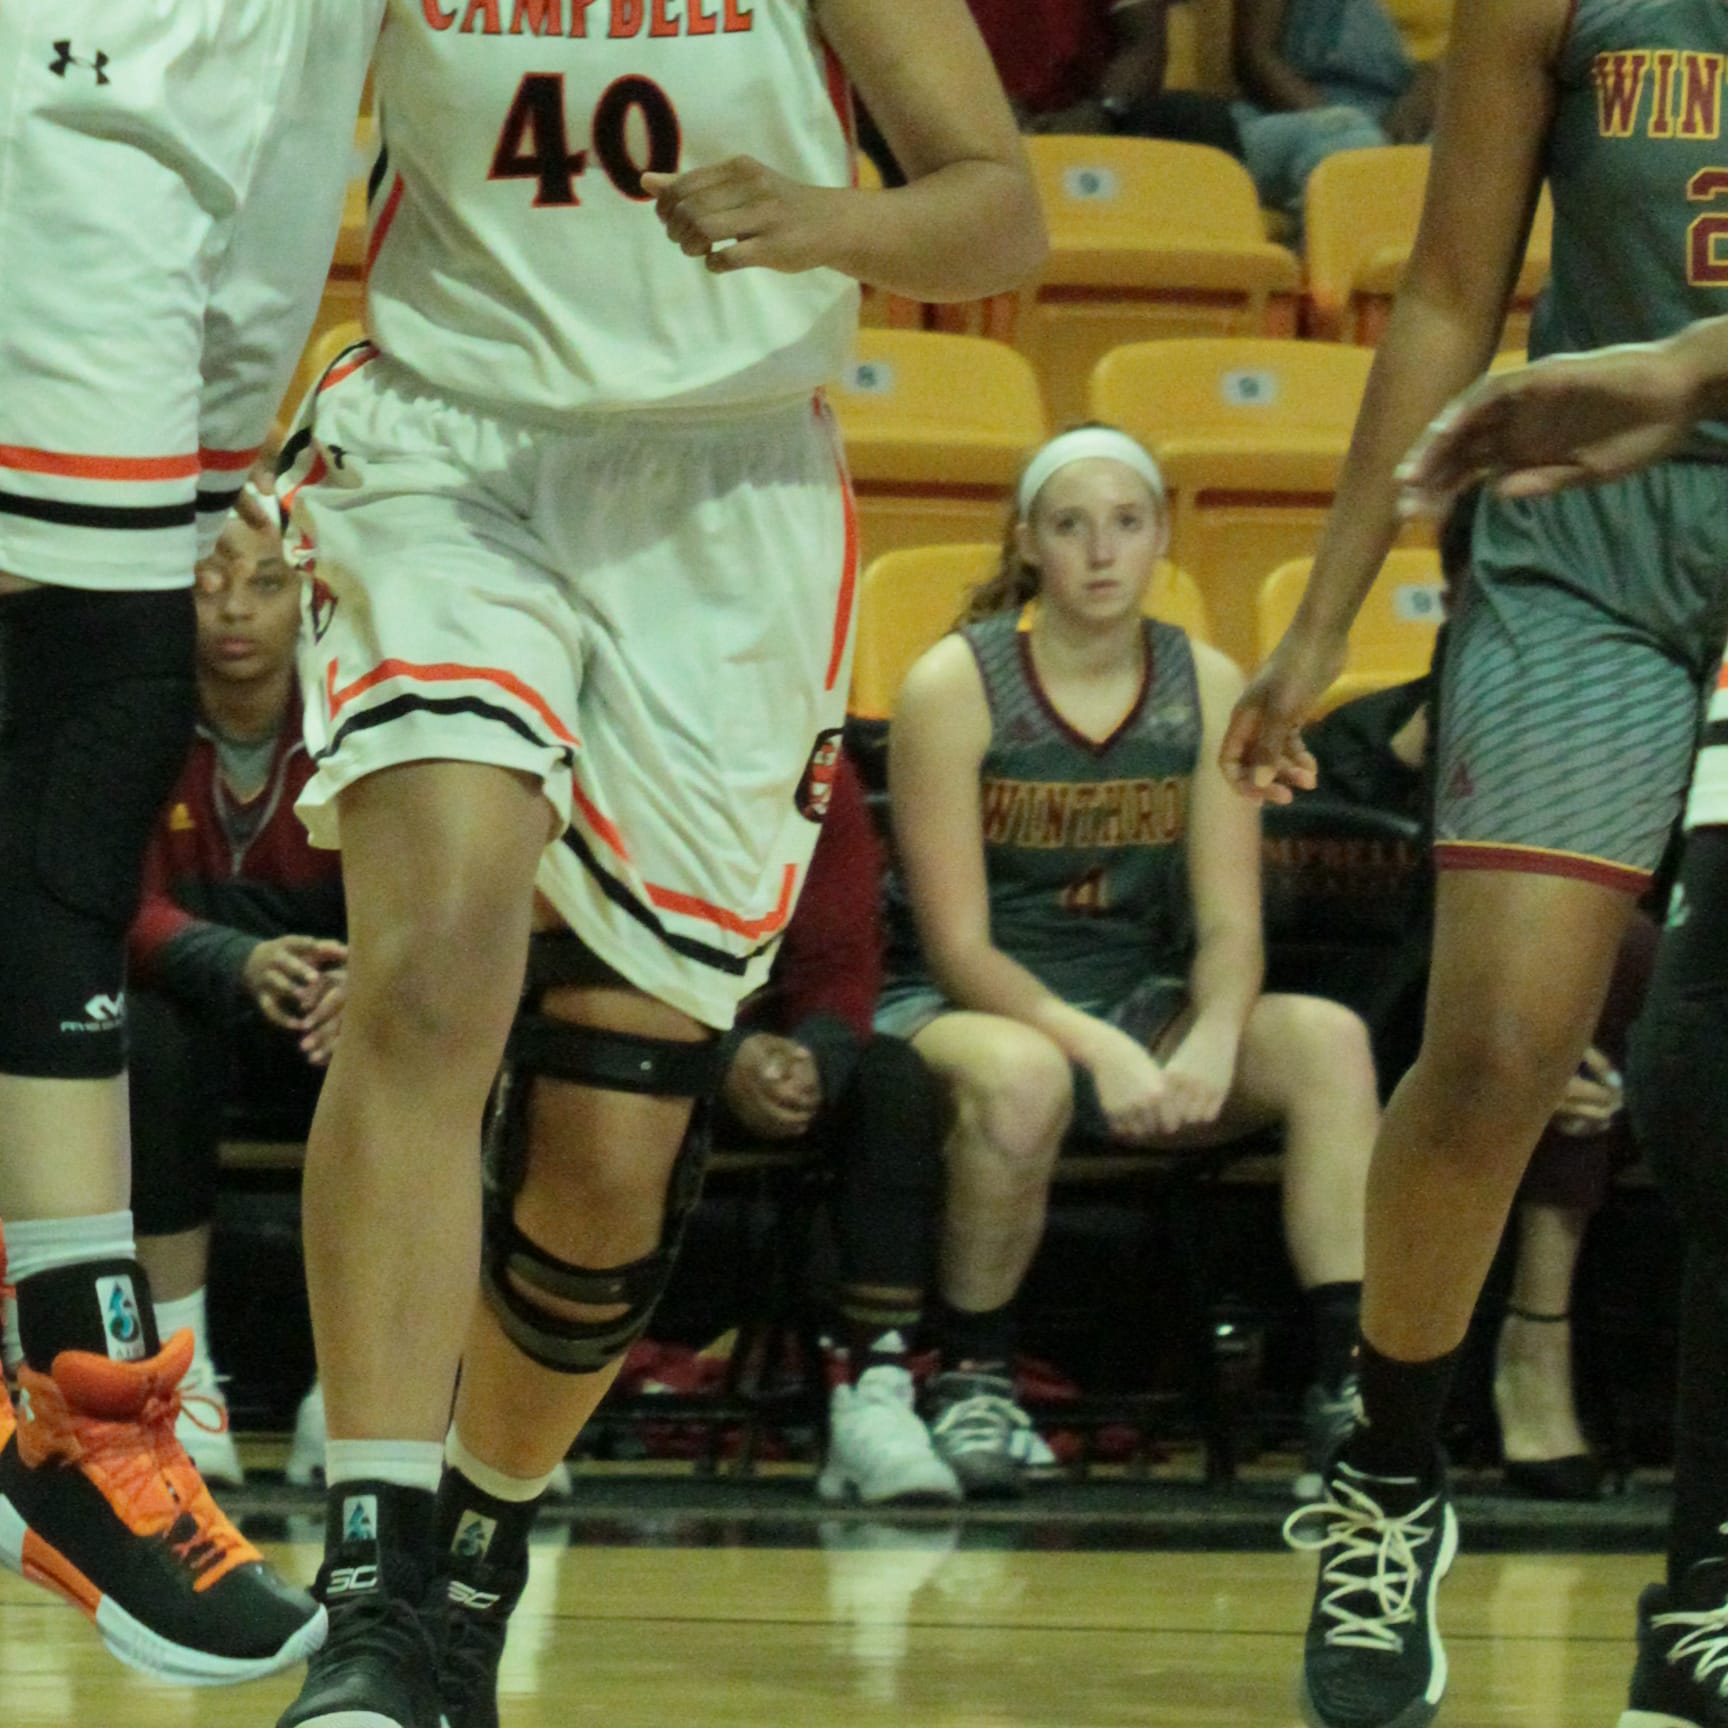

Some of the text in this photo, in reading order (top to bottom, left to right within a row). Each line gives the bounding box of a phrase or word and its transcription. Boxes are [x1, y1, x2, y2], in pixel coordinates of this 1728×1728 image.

[487, 72, 683, 208] 40
[1594, 48, 1728, 141] WIN
[982, 774, 1184, 848] WINTHRO
